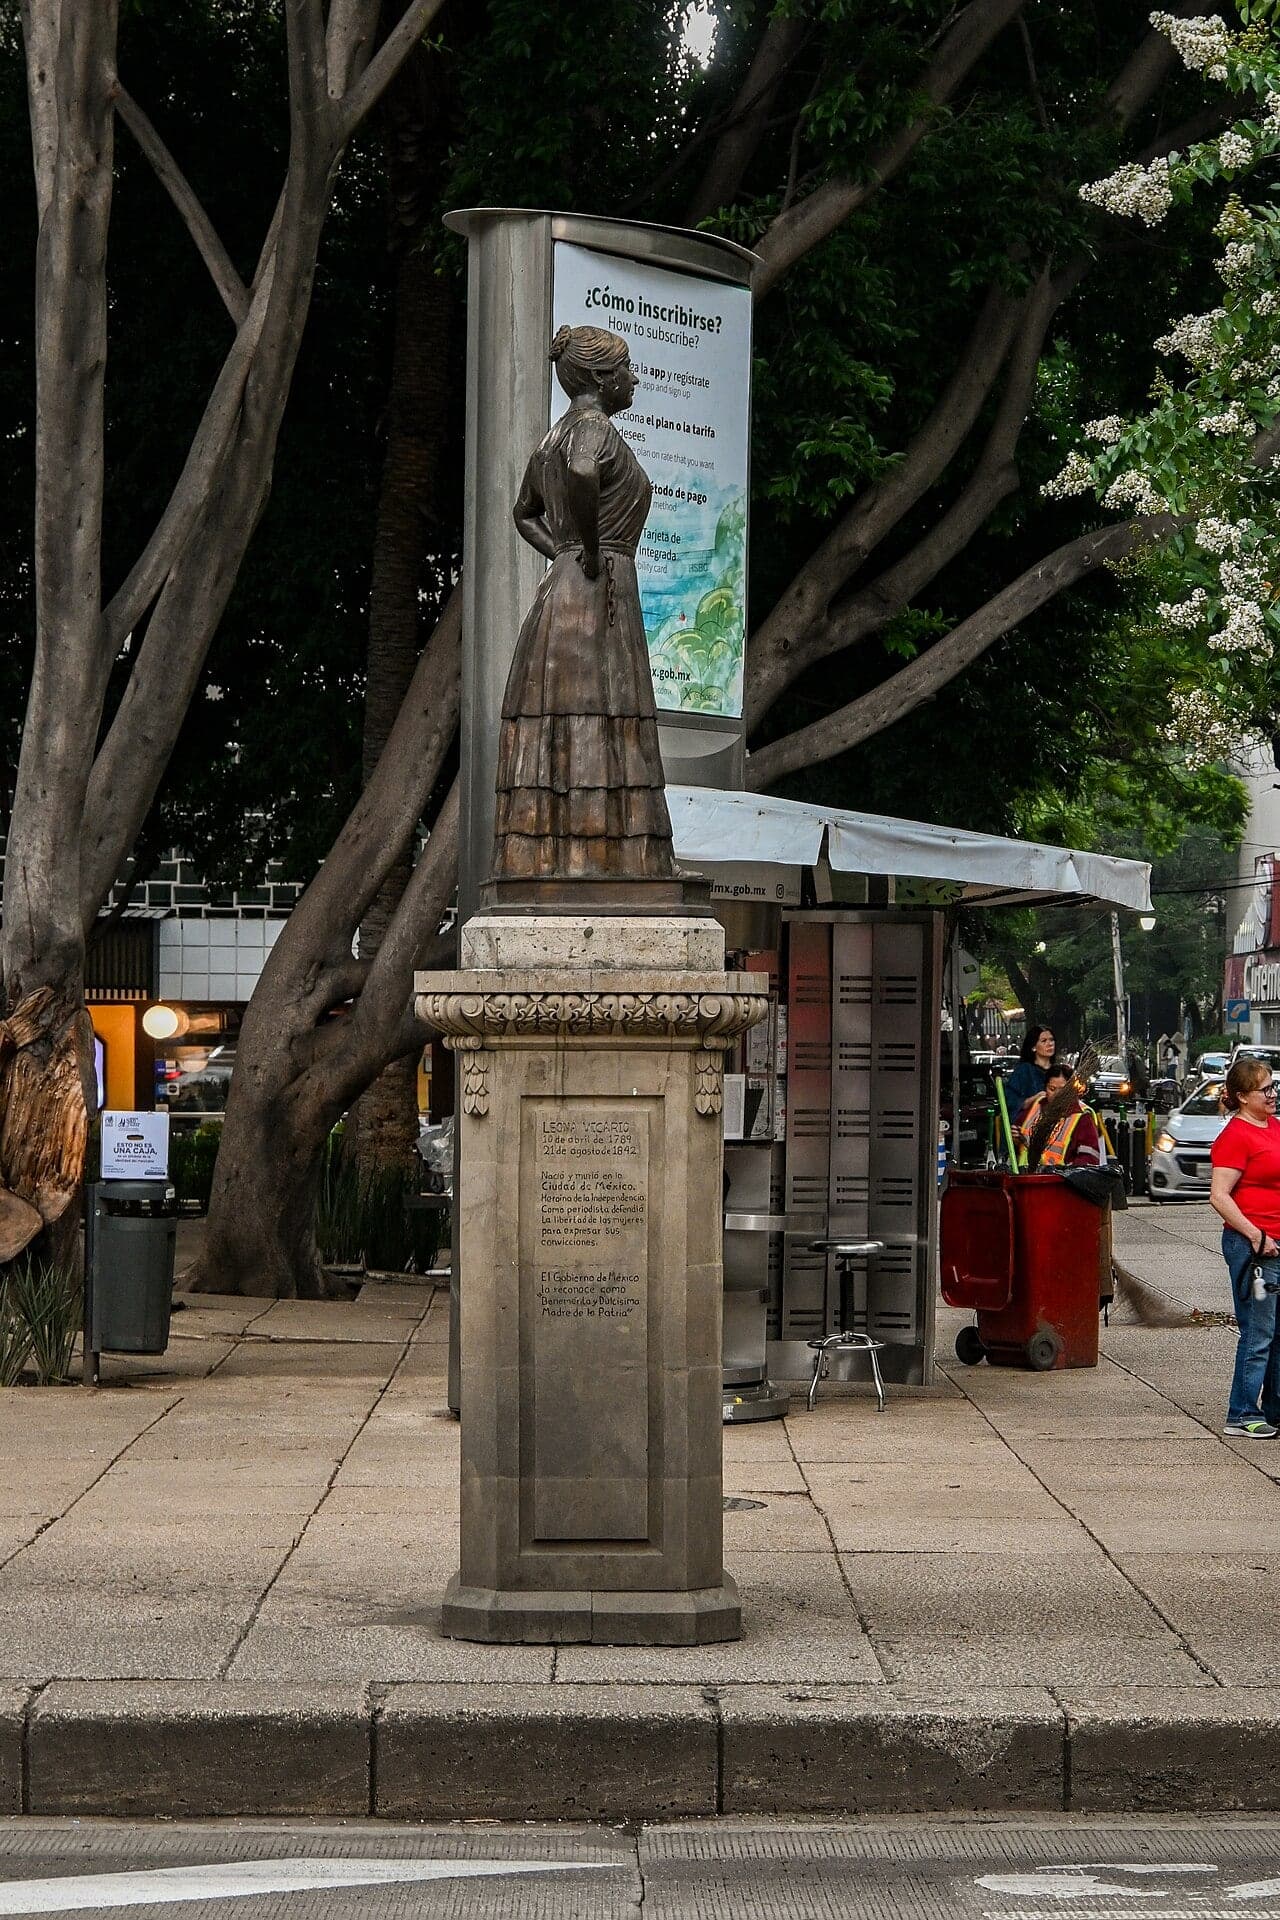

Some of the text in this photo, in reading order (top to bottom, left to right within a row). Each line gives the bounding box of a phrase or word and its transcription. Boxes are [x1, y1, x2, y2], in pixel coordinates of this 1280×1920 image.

[585, 285, 722, 334] ¿Cómo inscribirse?
[608, 315, 700, 349] How to subscribe?
[641, 362, 648, 375] la
[650, 366, 666, 380] app
[667, 371, 673, 383] y
[673, 371, 710, 389] regístrate
[642, 381, 655, 392] app
[655, 382, 668, 394] and
[668, 386, 682, 398] sign
[682, 390, 691, 400] up
[646, 415, 655, 426] el
[656, 417, 674, 430] plan
[676, 423, 682, 431] o
[683, 421, 691, 433] la
[692, 424, 716, 439] tarifa
[636, 447, 651, 458] plan
[661, 452, 673, 463] rate
[673, 454, 687, 465] that
[687, 458, 699, 468] you
[675, 487, 685, 499] de
[687, 491, 707, 505] pago
[643, 527, 681, 544] Tarjeta de
[639, 545, 677, 561] Integrada
[654, 564, 668, 574] card
[651, 666, 691, 682] x.gob.mx
[709, 884, 767, 897] dmx.gob.mx
[543, 1121, 630, 1133] LEONA VICARIO
[555, 1135, 566, 1144] de
[567, 1135, 591, 1144] abril
[593, 1134, 604, 1144] de
[555, 1146, 567, 1155] de
[570, 1145, 601, 1158] agosto
[613, 1145, 637, 1155] 1842
[541, 1170, 565, 1180] Nació
[567, 1174, 574, 1182] y
[541, 1180, 636, 1191] Ciudad de México.
[573, 1193, 583, 1202] de
[591, 1192, 645, 1203] Independencia
[541, 1204, 565, 1213] Como
[567, 1204, 610, 1215] periodista
[553, 1215, 587, 1224] libertad
[588, 1215, 598, 1224] de
[600, 1215, 612, 1224] las
[612, 1216, 645, 1226] mujeres
[541, 1227, 621, 1237] para expresar sus
[541, 1271, 640, 1282] El Gobierno de México
[541, 1284, 626, 1294] la reconoce como
[591, 1299, 598, 1307] y
[542, 1307, 571, 1317] Madre
[573, 1307, 584, 1317] de
[587, 1307, 595, 1317] la
